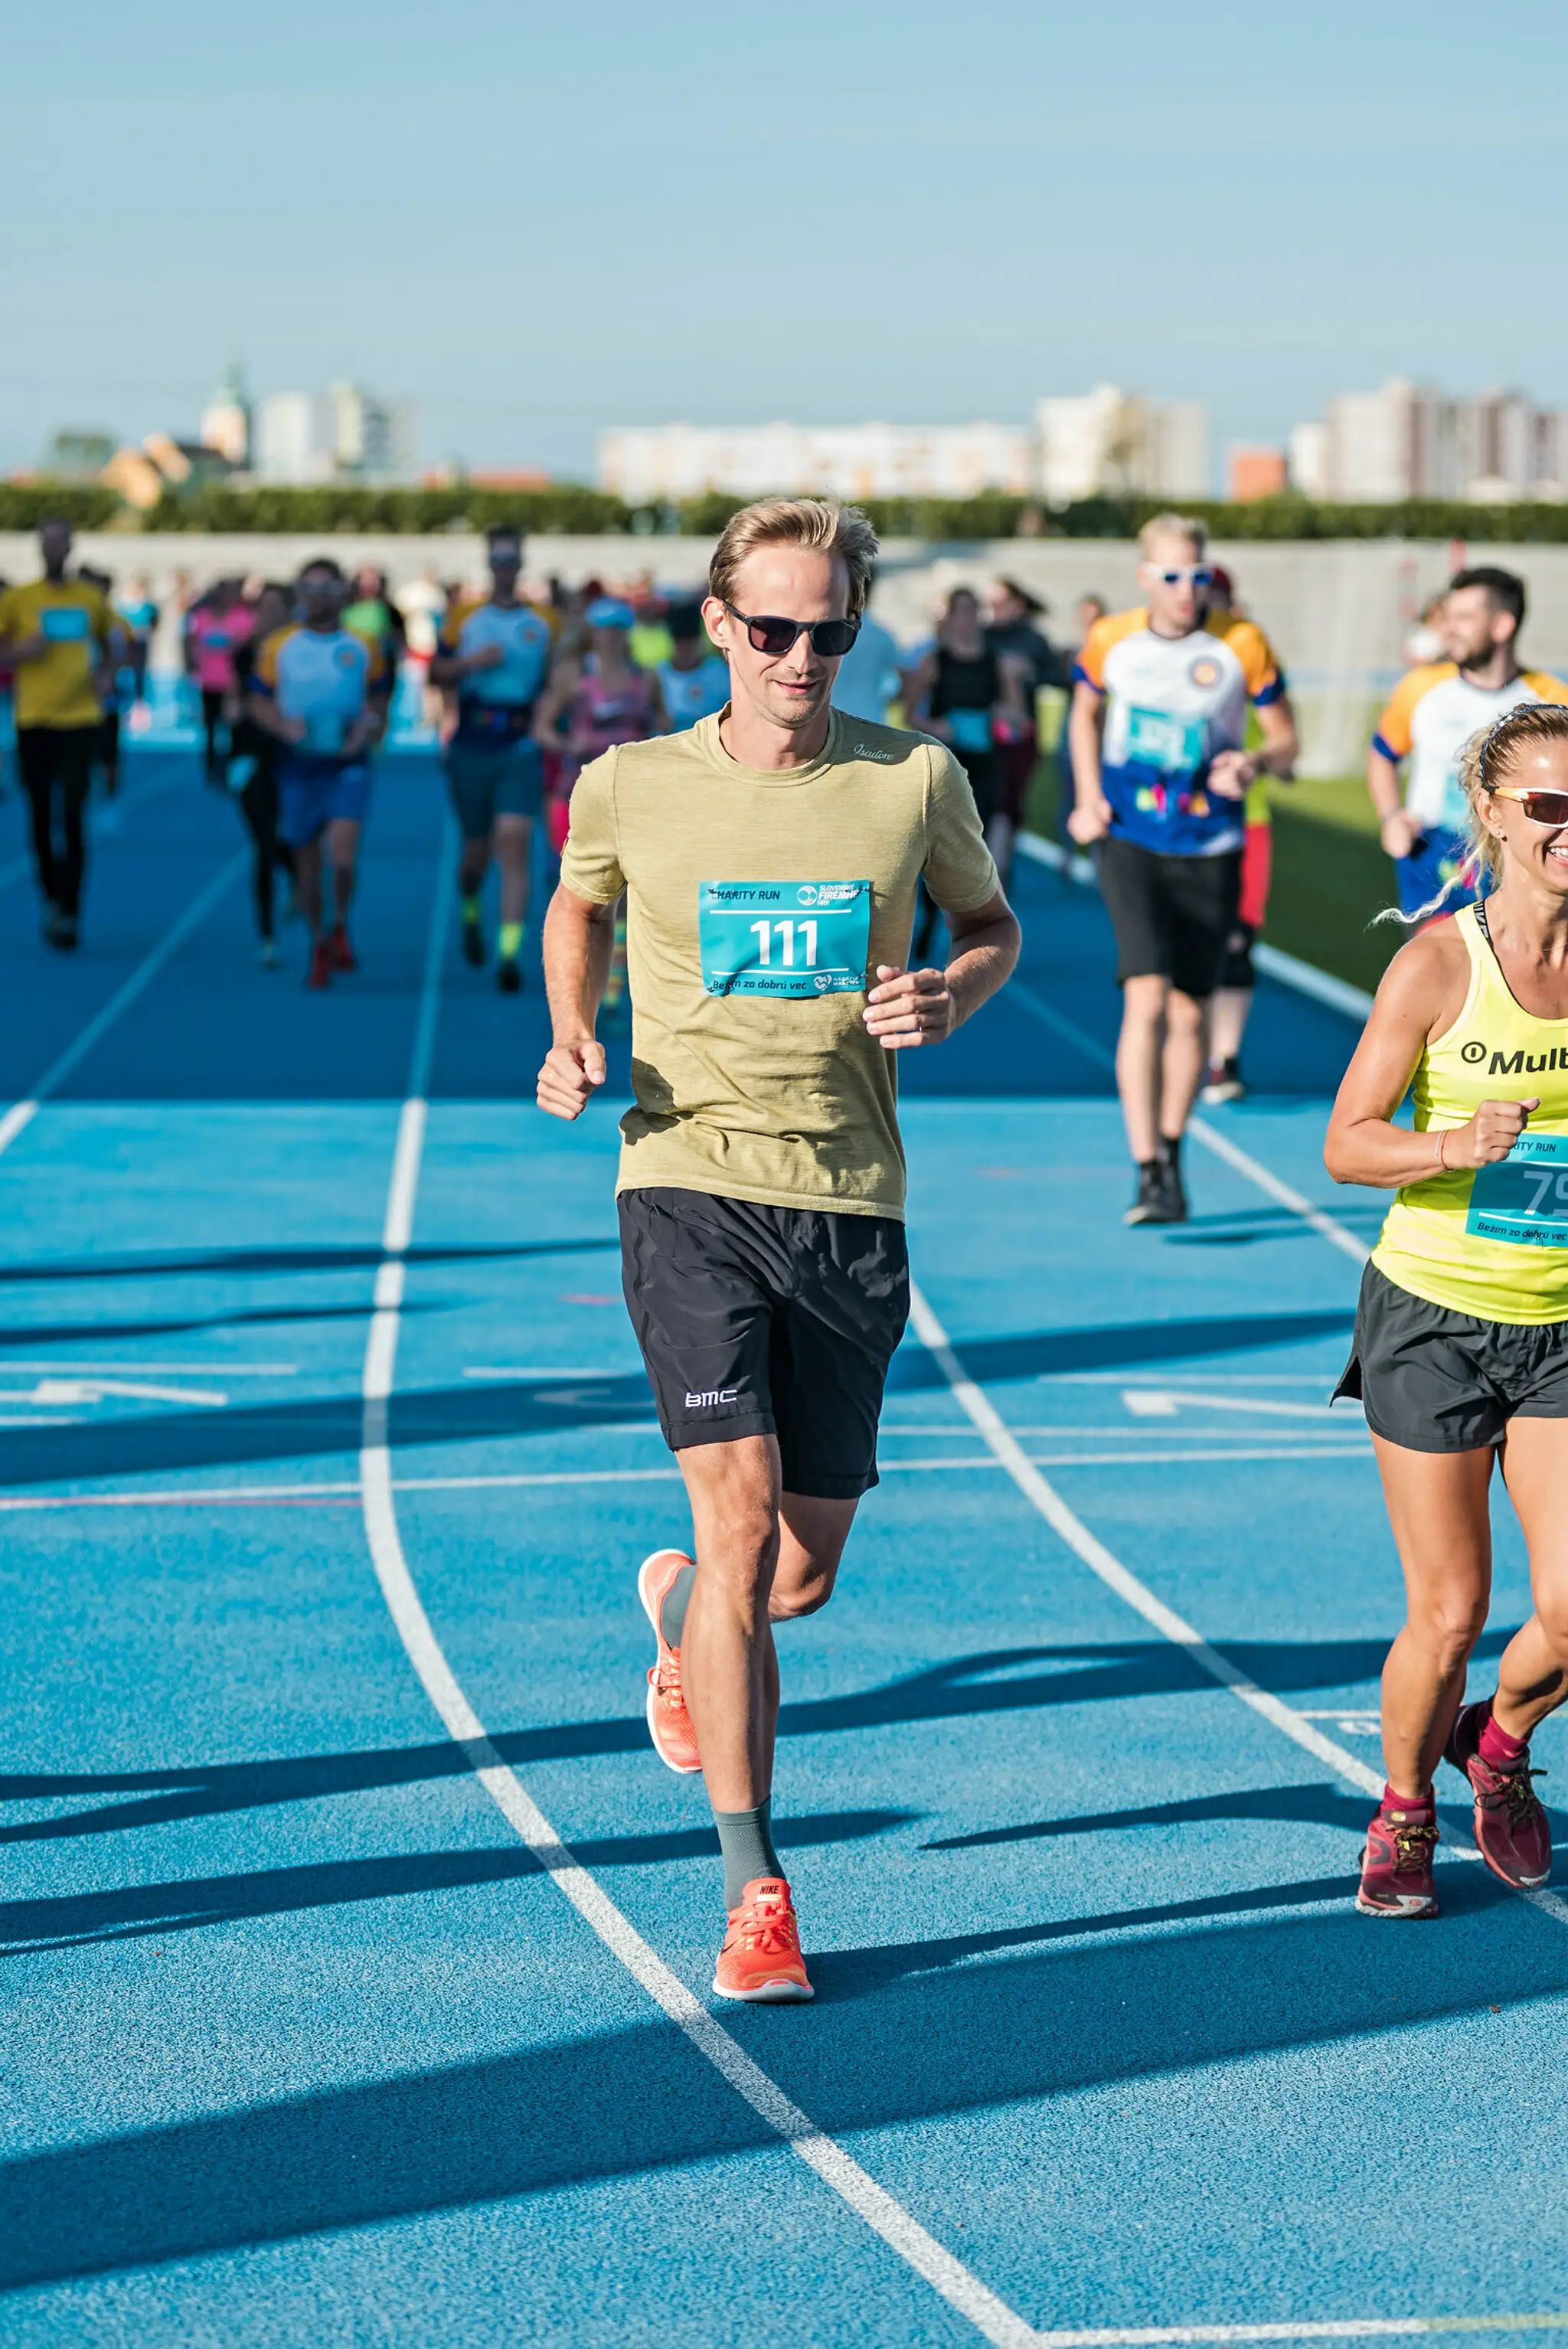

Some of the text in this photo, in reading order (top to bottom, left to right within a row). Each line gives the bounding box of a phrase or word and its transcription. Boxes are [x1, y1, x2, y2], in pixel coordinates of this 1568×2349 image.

[758, 890, 781, 900] RUN
[750, 920, 818, 966] 111
[743, 980, 755, 988] za
[789, 982, 808, 990] vec
[1536, 1142, 1557, 1152] RUN
[1551, 1232, 1566, 1240] vec
[685, 1389, 737, 1408] BMC
[760, 1885, 779, 1895] NIKE
